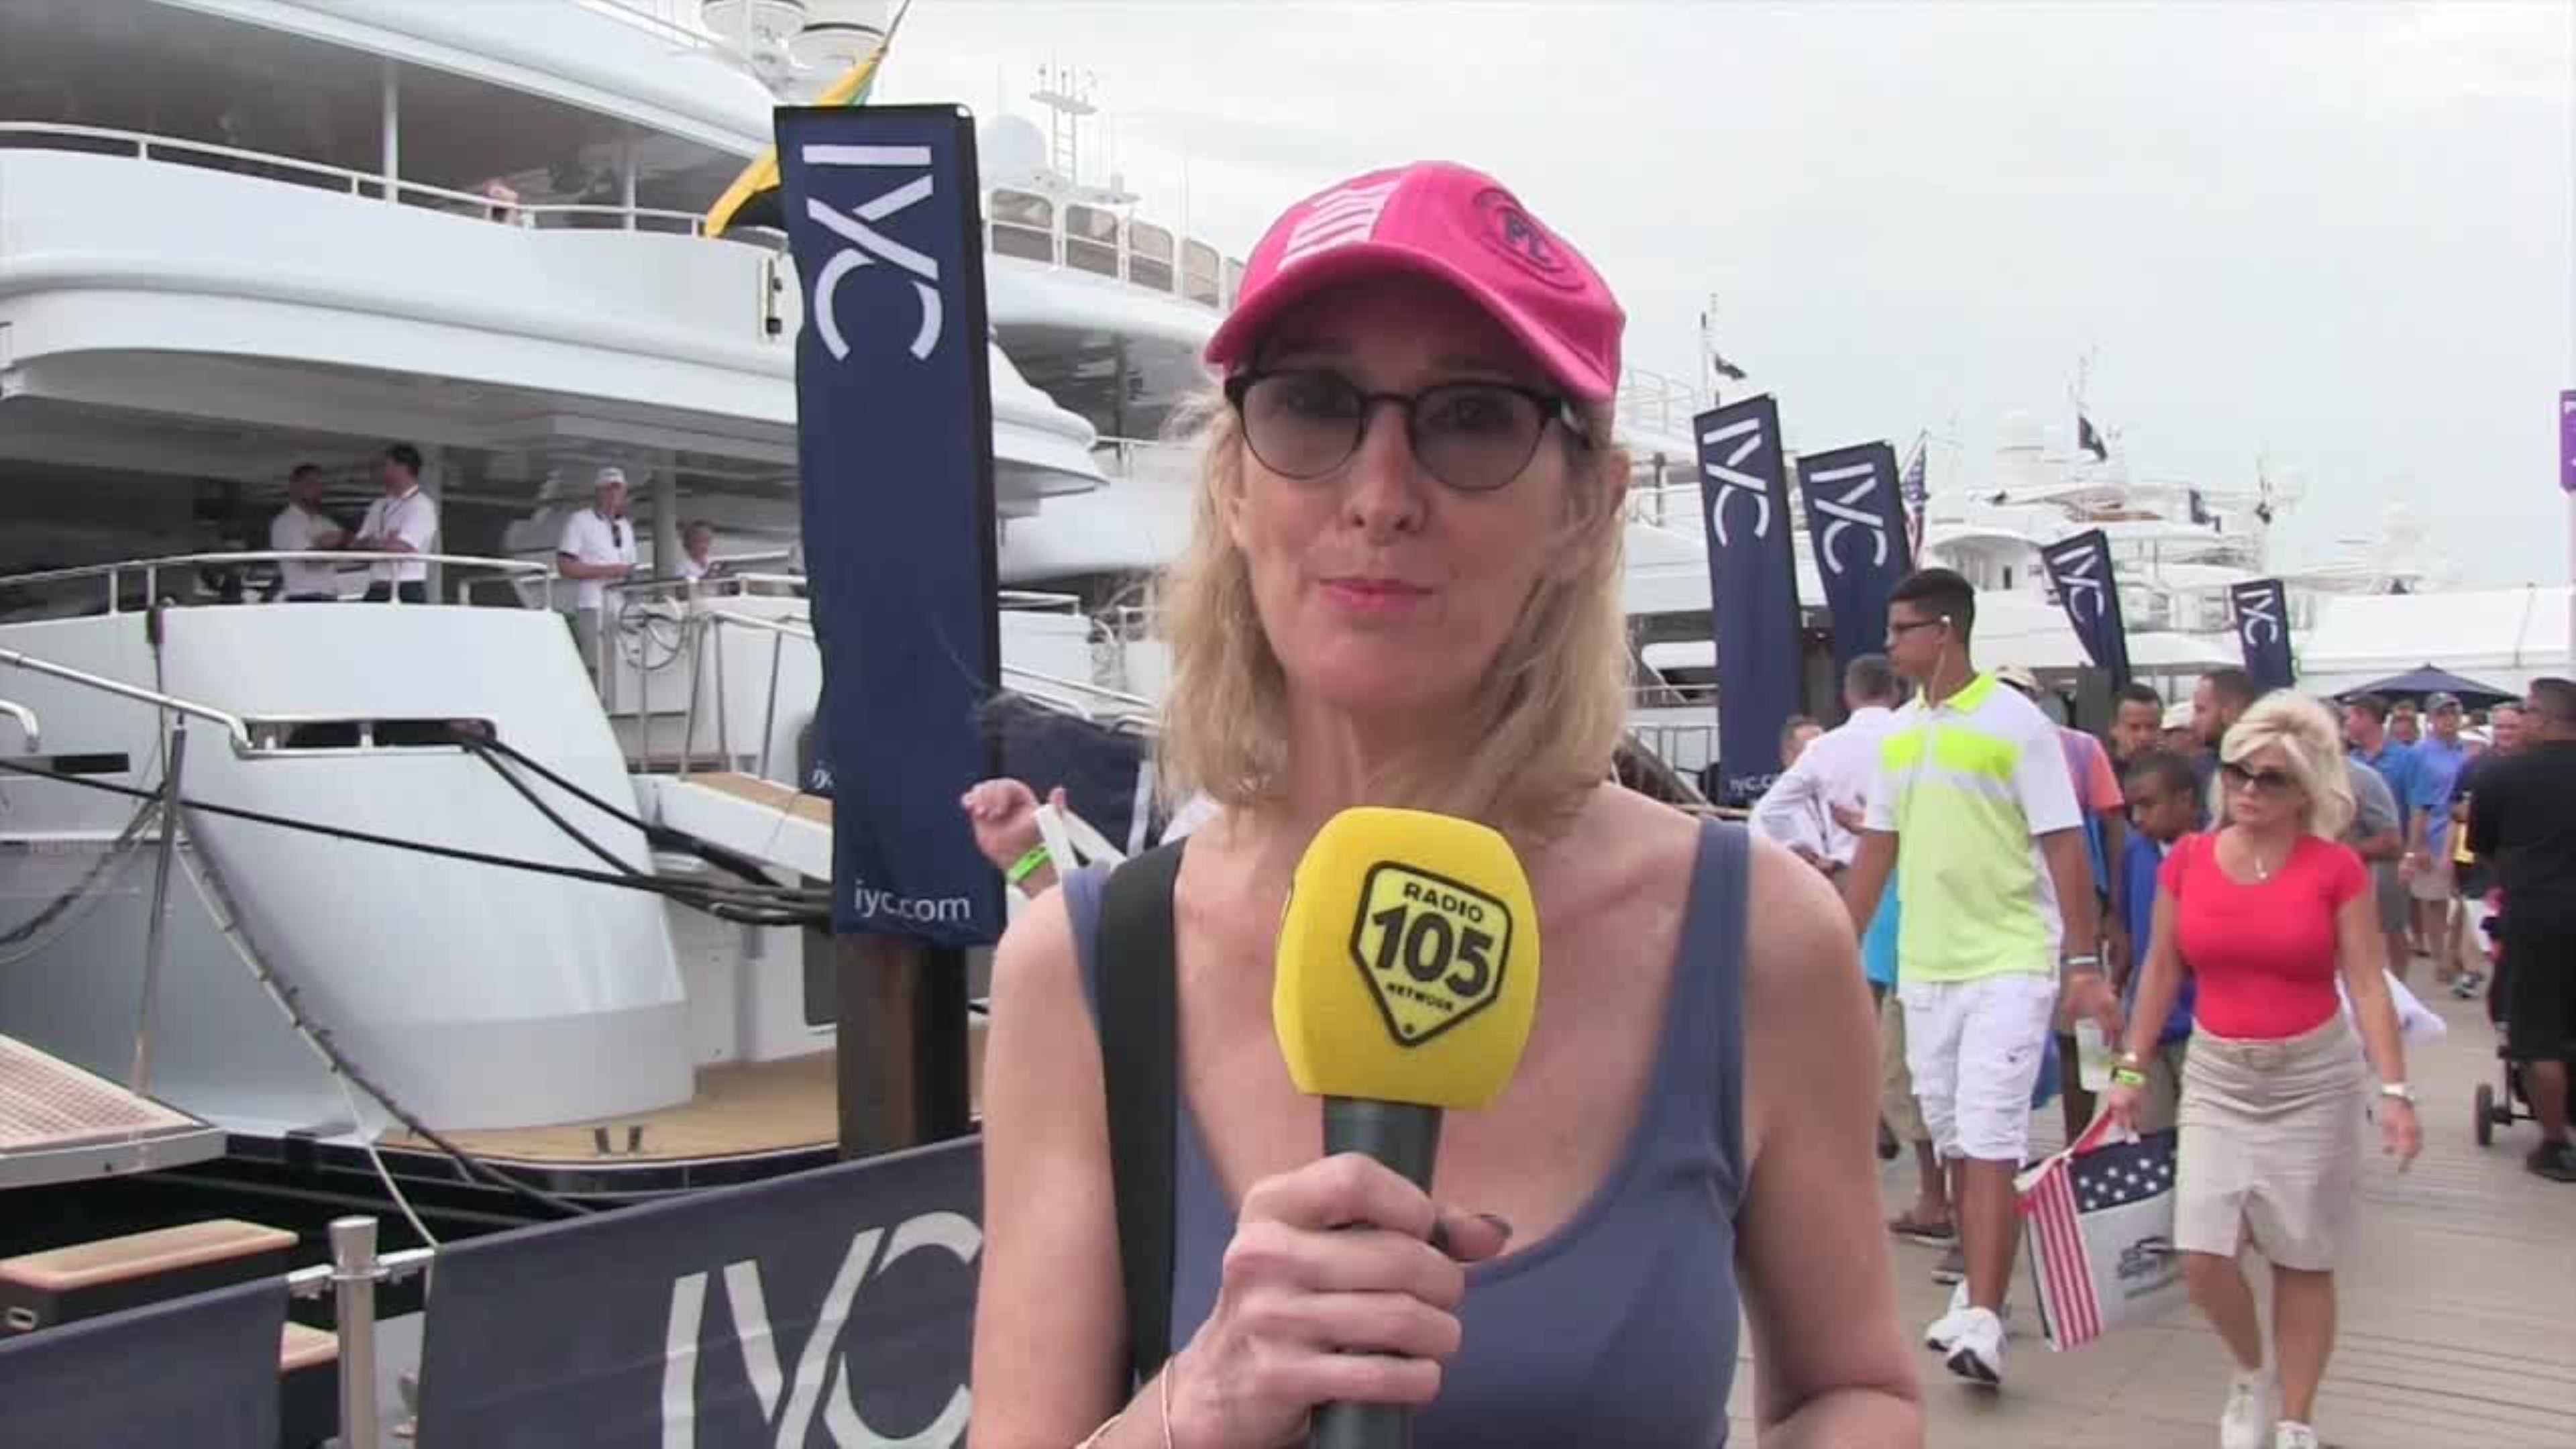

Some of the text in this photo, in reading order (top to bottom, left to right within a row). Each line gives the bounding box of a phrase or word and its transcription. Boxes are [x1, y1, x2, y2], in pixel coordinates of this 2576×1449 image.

[802, 144, 942, 361] IYC
[1703, 417, 1770, 547] IYC
[1811, 463, 1888, 574] IYC
[2051, 545, 2104, 624] IYC
[2237, 588, 2278, 645] IYC
[854, 878, 971, 922] iyc.com
[1403, 882, 1484, 923] RADIO
[1373, 905, 1493, 997] 105
[661, 1212, 982, 1449] IYC
